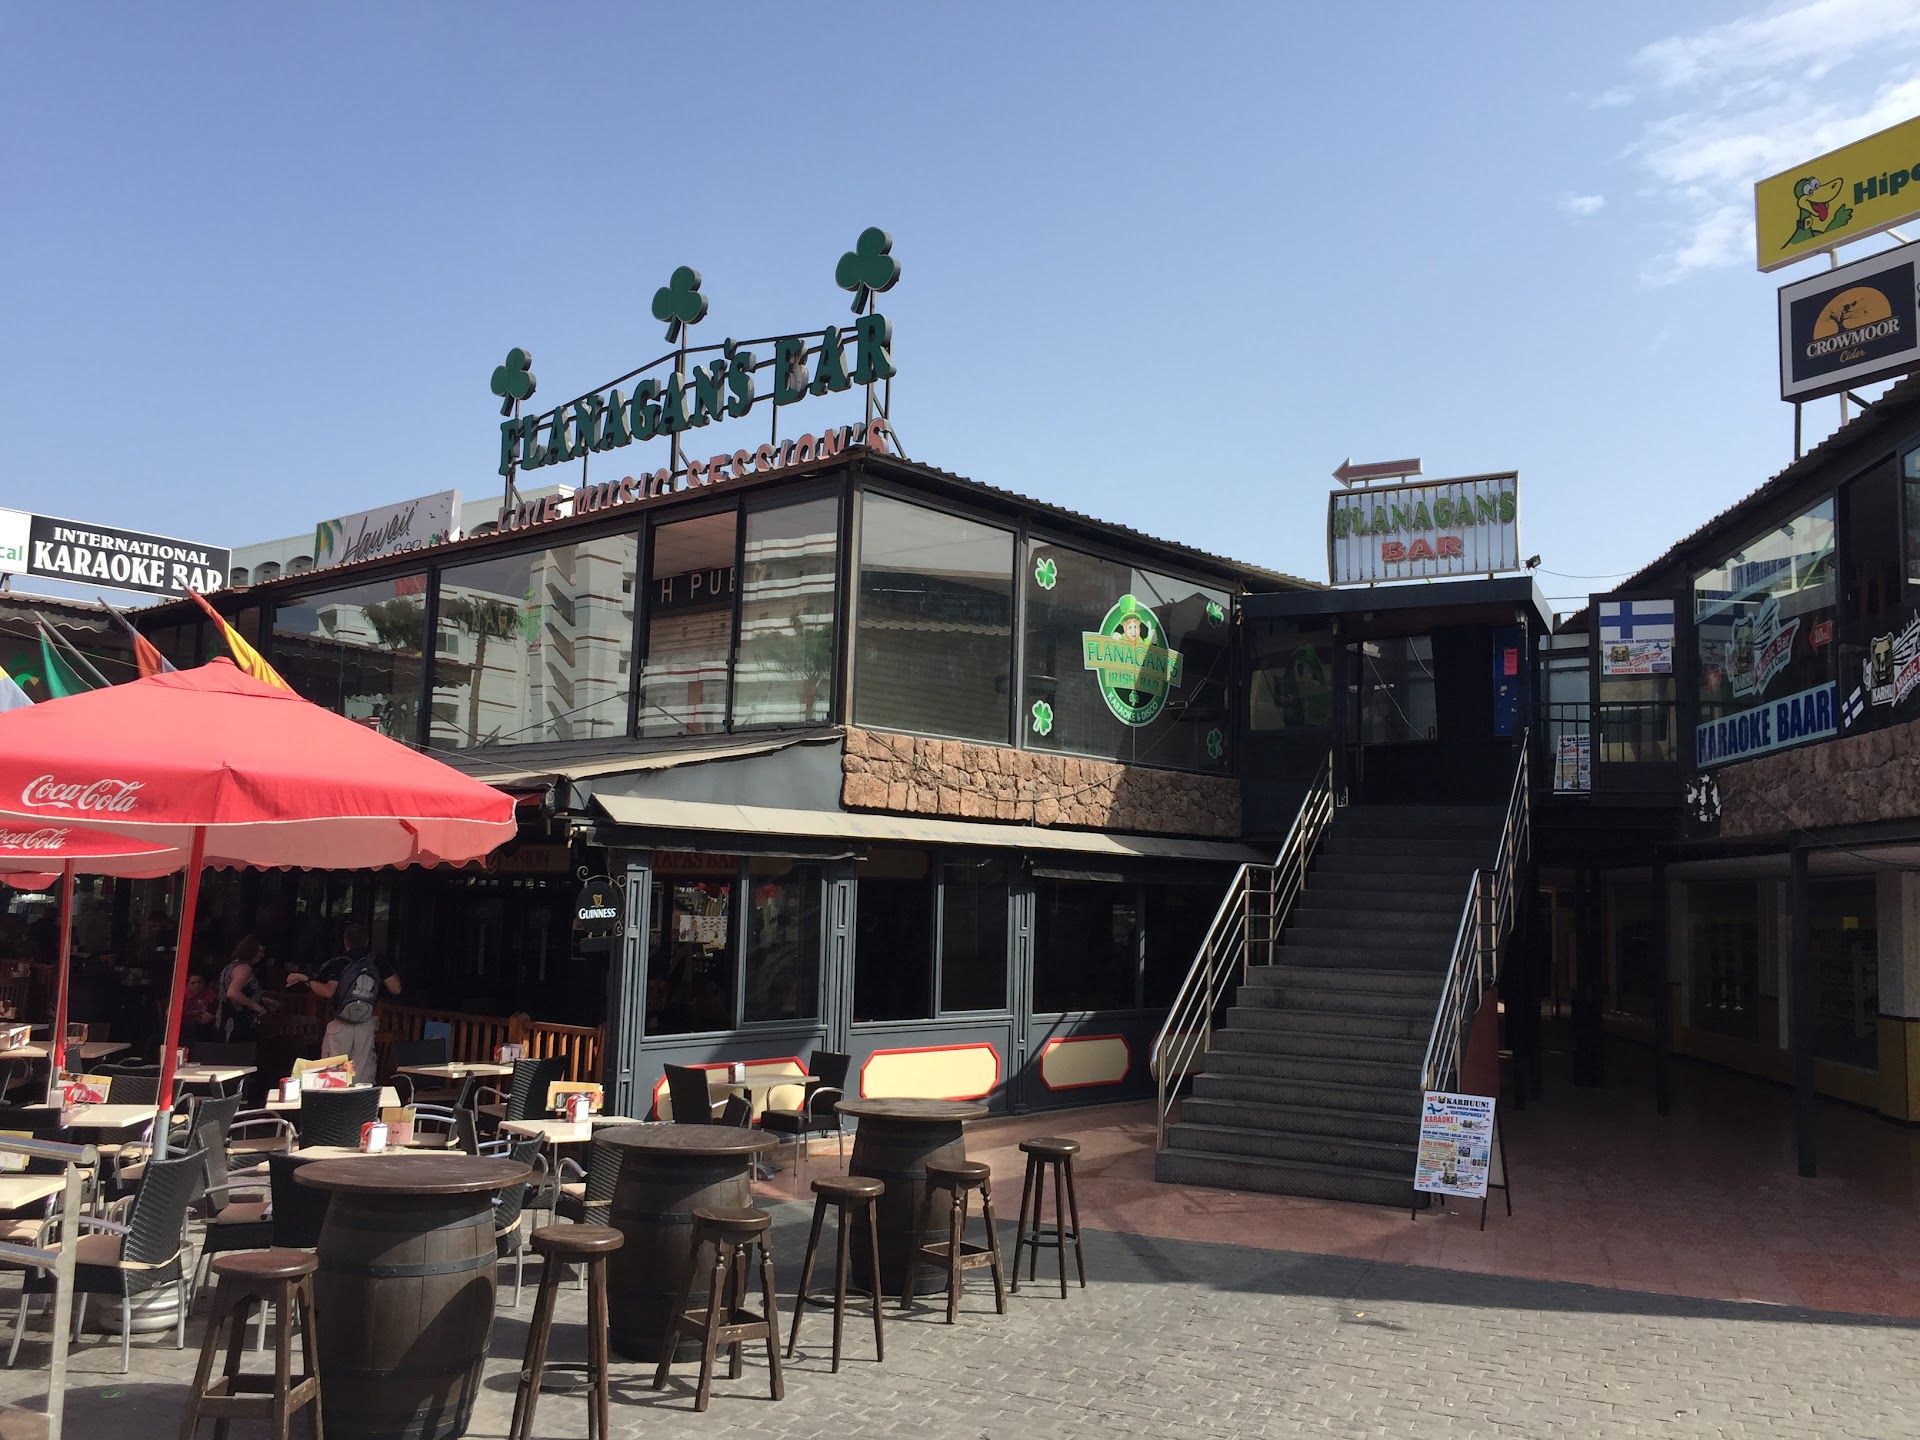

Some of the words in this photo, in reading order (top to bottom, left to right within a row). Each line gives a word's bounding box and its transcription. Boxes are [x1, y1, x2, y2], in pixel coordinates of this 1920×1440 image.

[1806, 318, 1900, 357] CROWMOOR
[1840, 349, 1867, 363] Cider
[498, 337, 757, 475] FLANAGAN'S
[773, 313, 897, 406] BAR
[572, 468, 673, 517] MUSIC
[686, 417, 892, 489] SESSION'S
[1334, 491, 1516, 540] FLANAGANS
[53, 526, 210, 567] INTERNATIONAL
[339, 501, 420, 563] Hawaii
[1381, 536, 1463, 565] BAR
[33, 540, 166, 589] KARAOKE
[171, 563, 223, 594] BAR
[1776, 634, 1791, 652] Bar
[1873, 685, 1893, 701] KARHU
[1895, 662, 1918, 694] Music
[1107, 691, 1137, 721] KARAOKE
[1141, 701, 1159, 720] DISCO
[1698, 708, 1771, 764] KARAOKE
[1777, 685, 1837, 743] BAARI
[22, 774, 146, 812] Coca-Cola
[0, 828, 73, 850] oca-Cola
[578, 907, 617, 920] GUINNESS
[1446, 1098, 1489, 1108] KARHUUN!
[1424, 1116, 1455, 1124] KARAOKE
